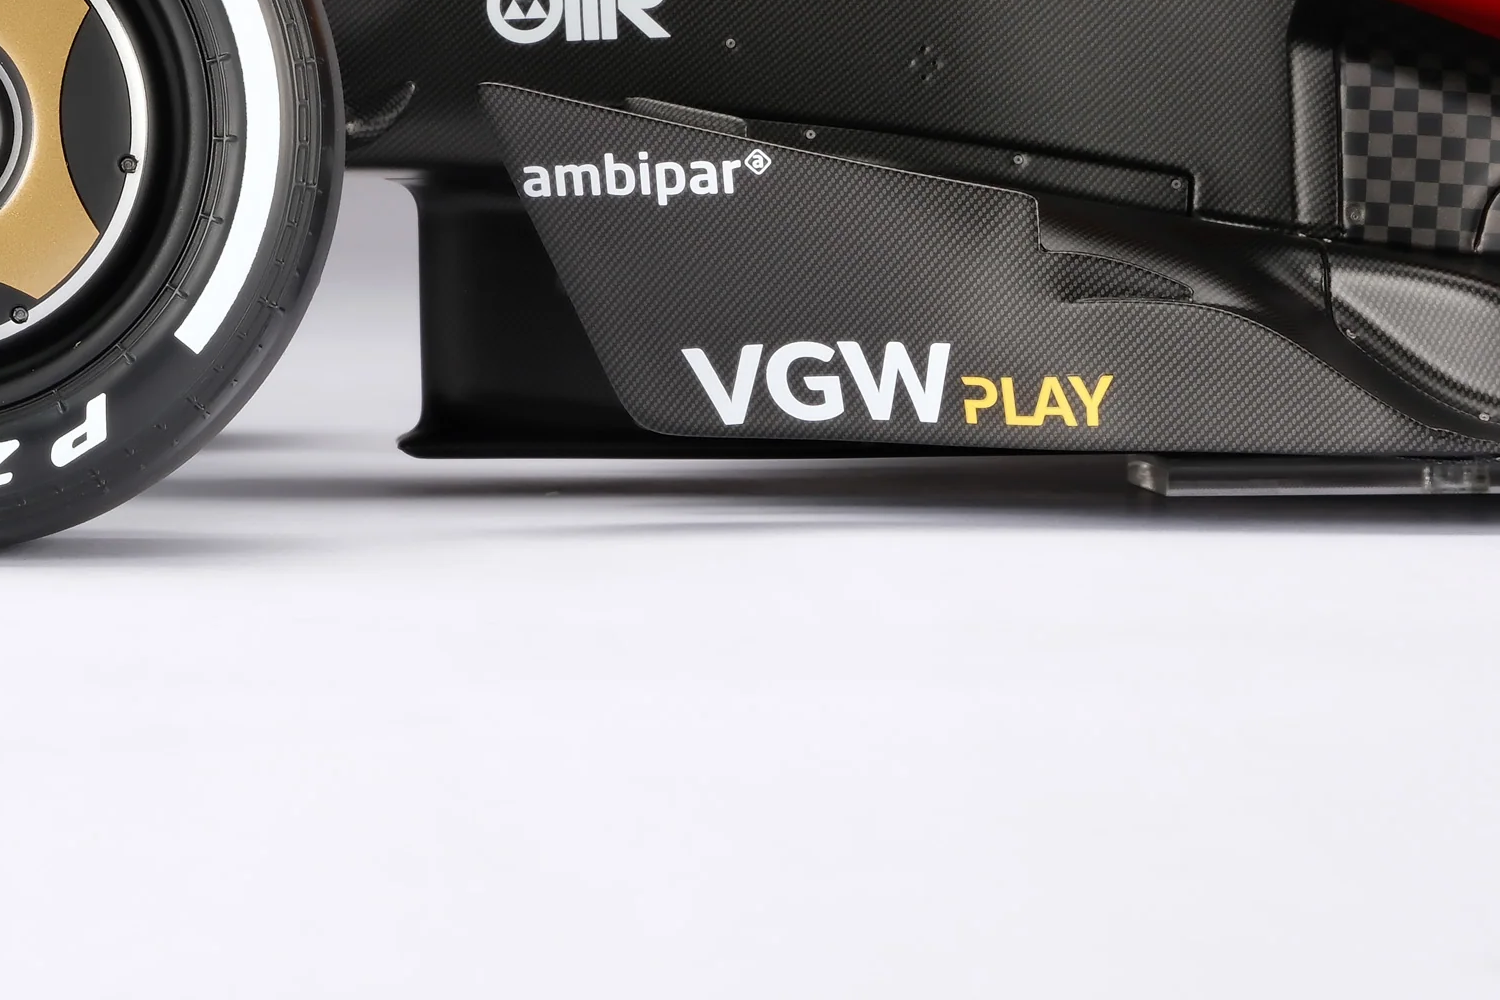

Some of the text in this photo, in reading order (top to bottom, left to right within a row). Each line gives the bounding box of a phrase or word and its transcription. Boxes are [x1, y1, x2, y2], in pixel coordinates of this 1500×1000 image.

[522, 151, 742, 206] ambipar
[680, 340, 1114, 428] VGW PLAY
[50, 392, 108, 468] P
